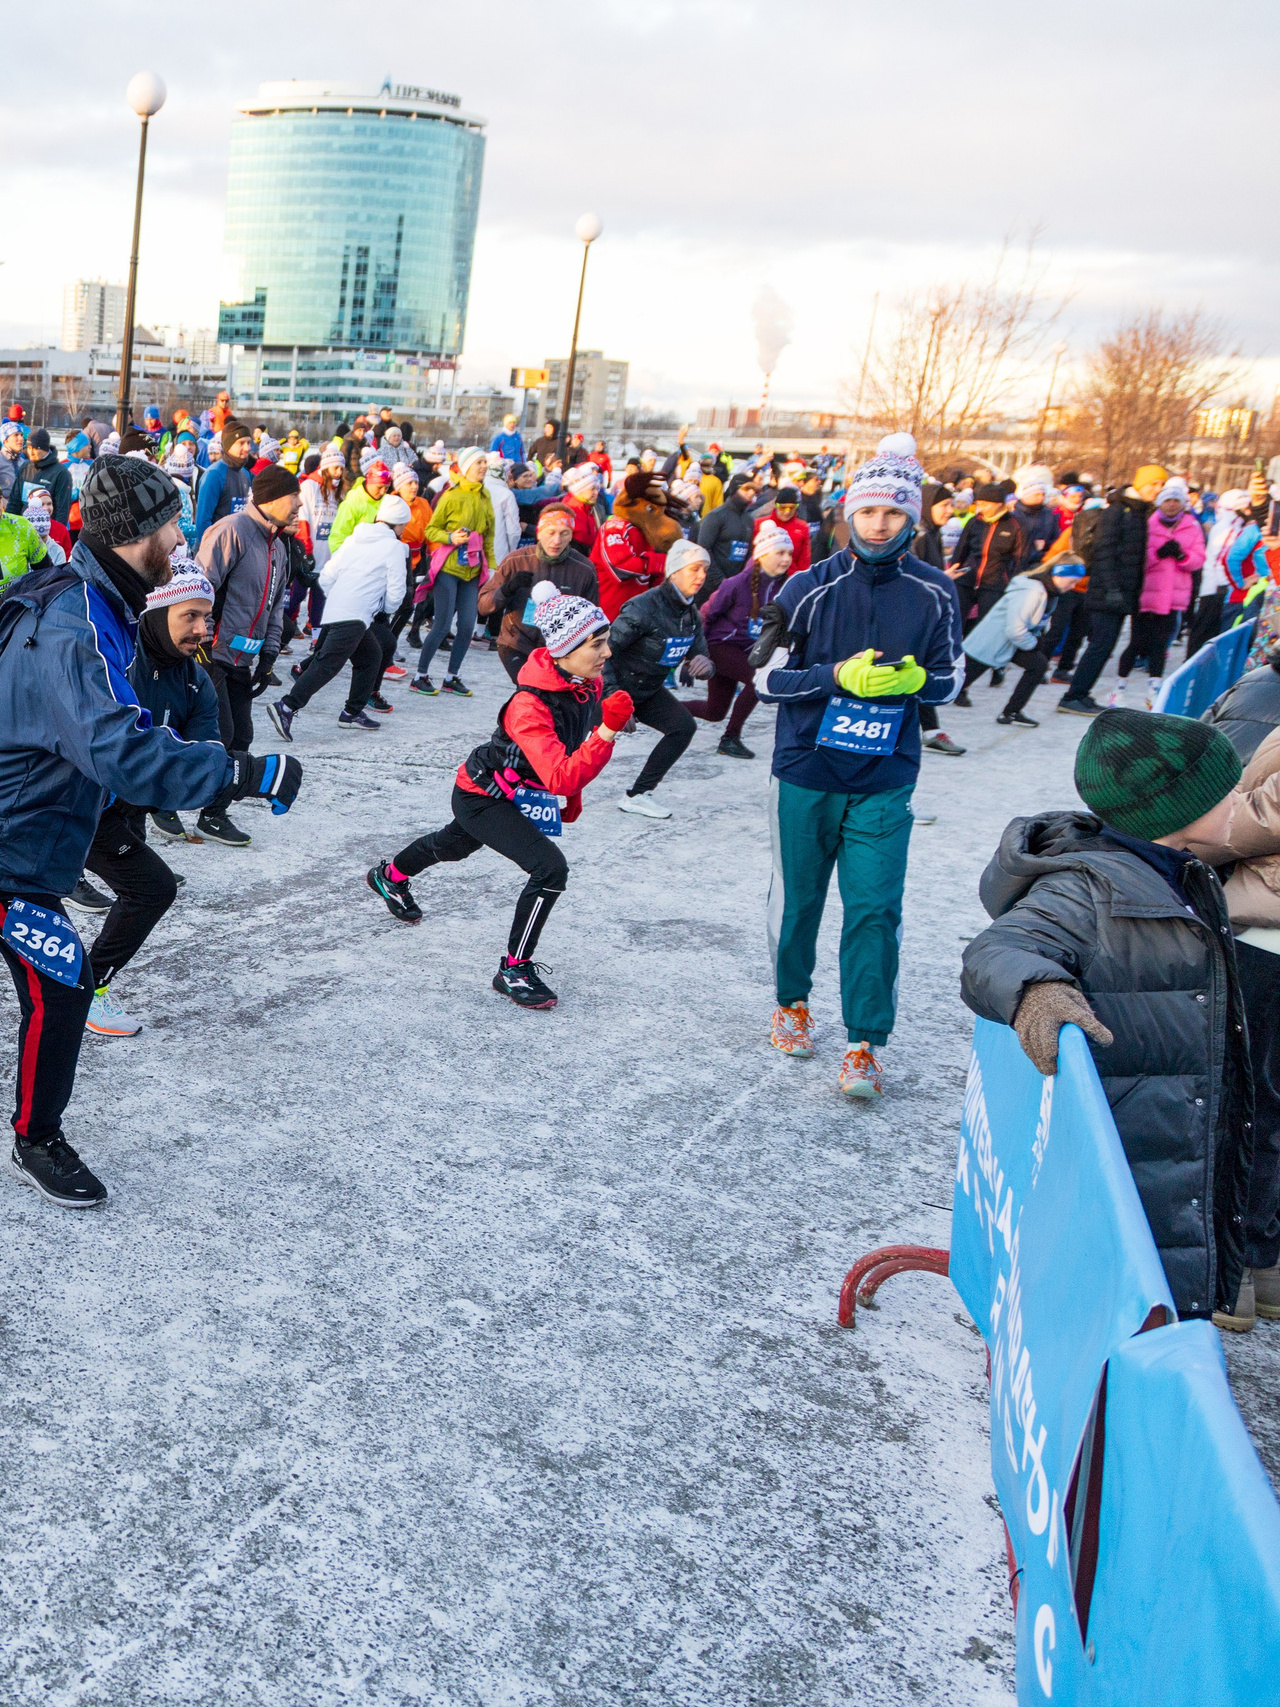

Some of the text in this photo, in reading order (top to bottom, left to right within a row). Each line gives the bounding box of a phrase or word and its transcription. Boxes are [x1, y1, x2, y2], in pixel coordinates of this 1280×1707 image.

[243, 638, 261, 651] 117
[832, 715, 892, 740] 2481
[520, 803, 557, 822] 2801
[36, 911, 46, 919] KM
[10, 922, 76, 964] 2364
